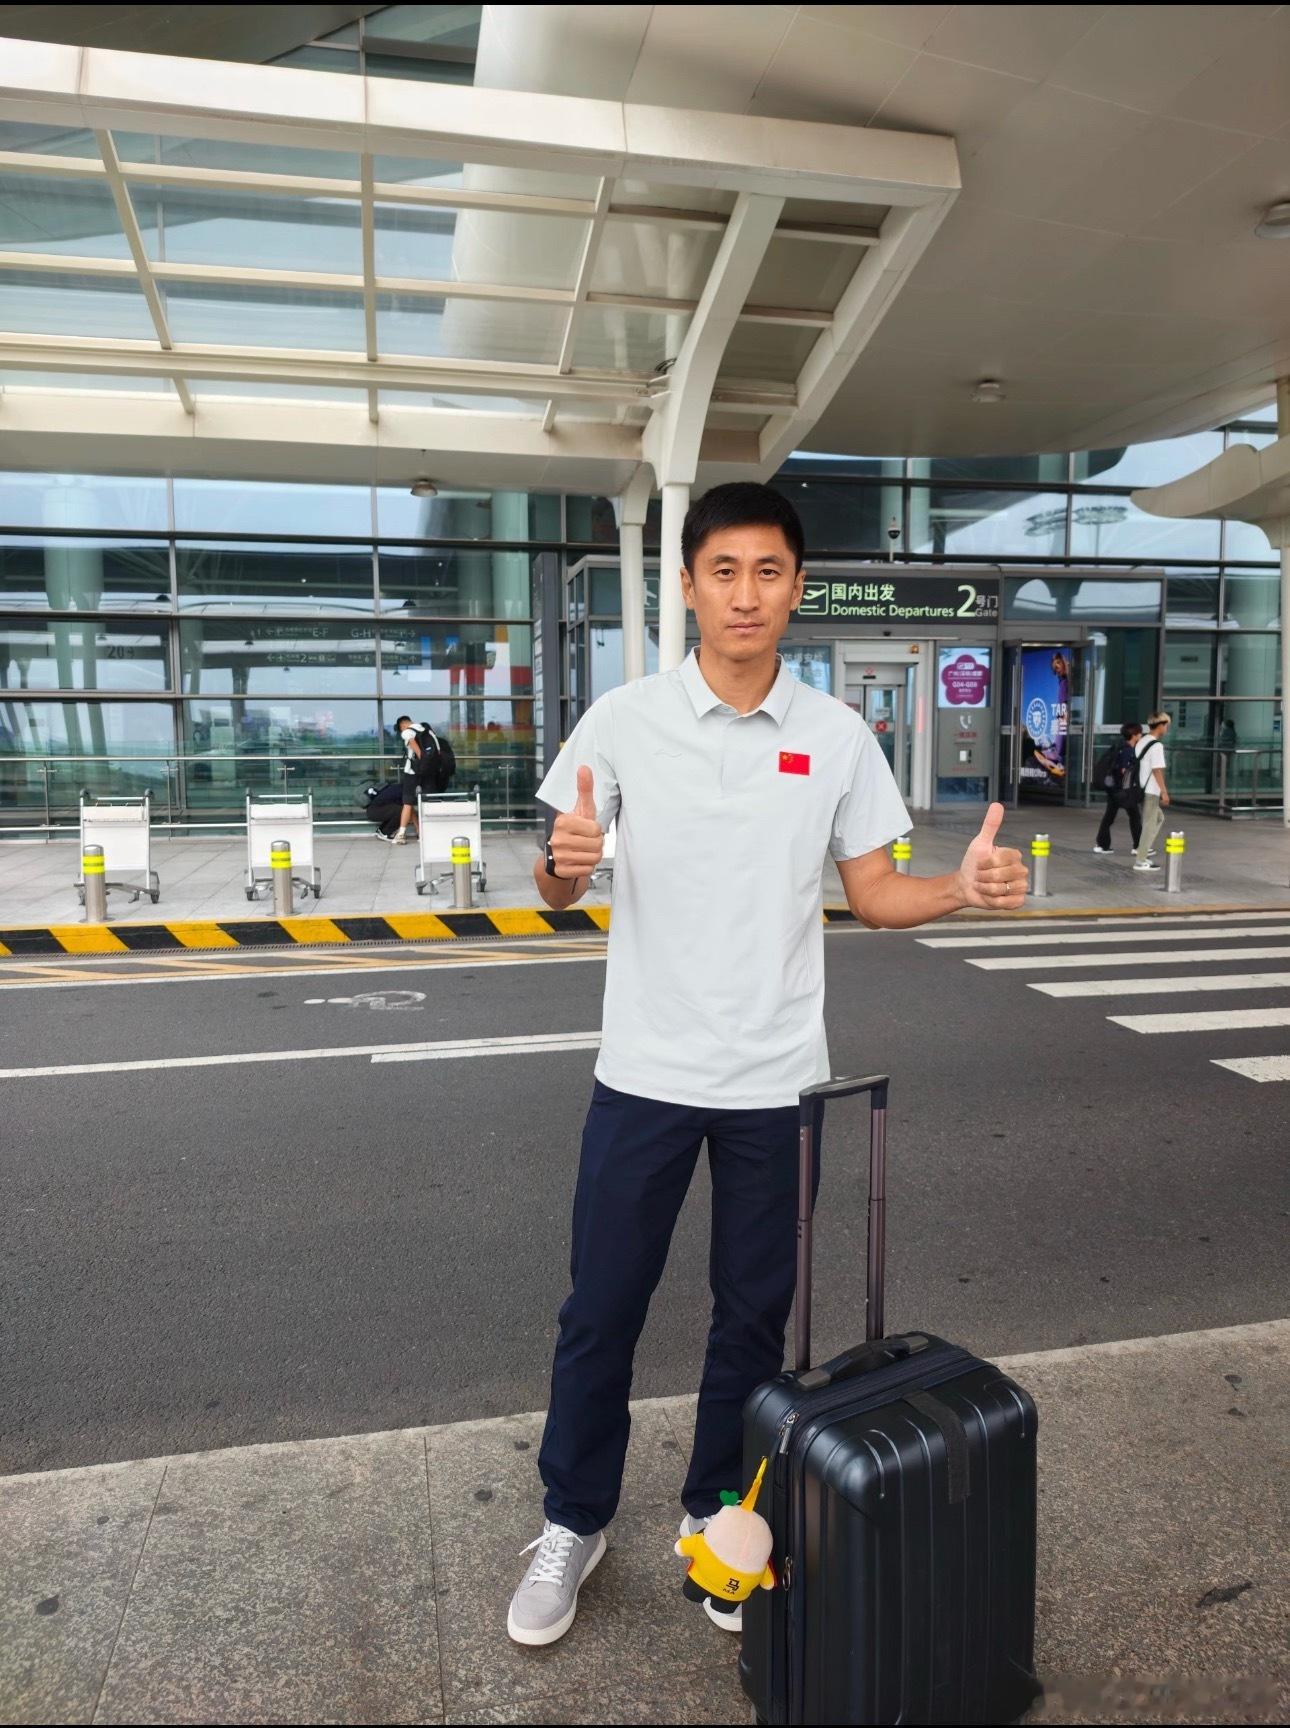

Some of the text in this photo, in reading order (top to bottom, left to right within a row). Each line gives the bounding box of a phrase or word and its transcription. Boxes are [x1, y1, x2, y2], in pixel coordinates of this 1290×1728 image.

[831, 583, 896, 601] 国内出发
[957, 584, 976, 618] 2
[976, 594, 998, 608] 号门
[831, 604, 955, 619] Domestic Departures
[975, 607, 998, 618] Gate
[725, 1577, 740, 1591] 马
